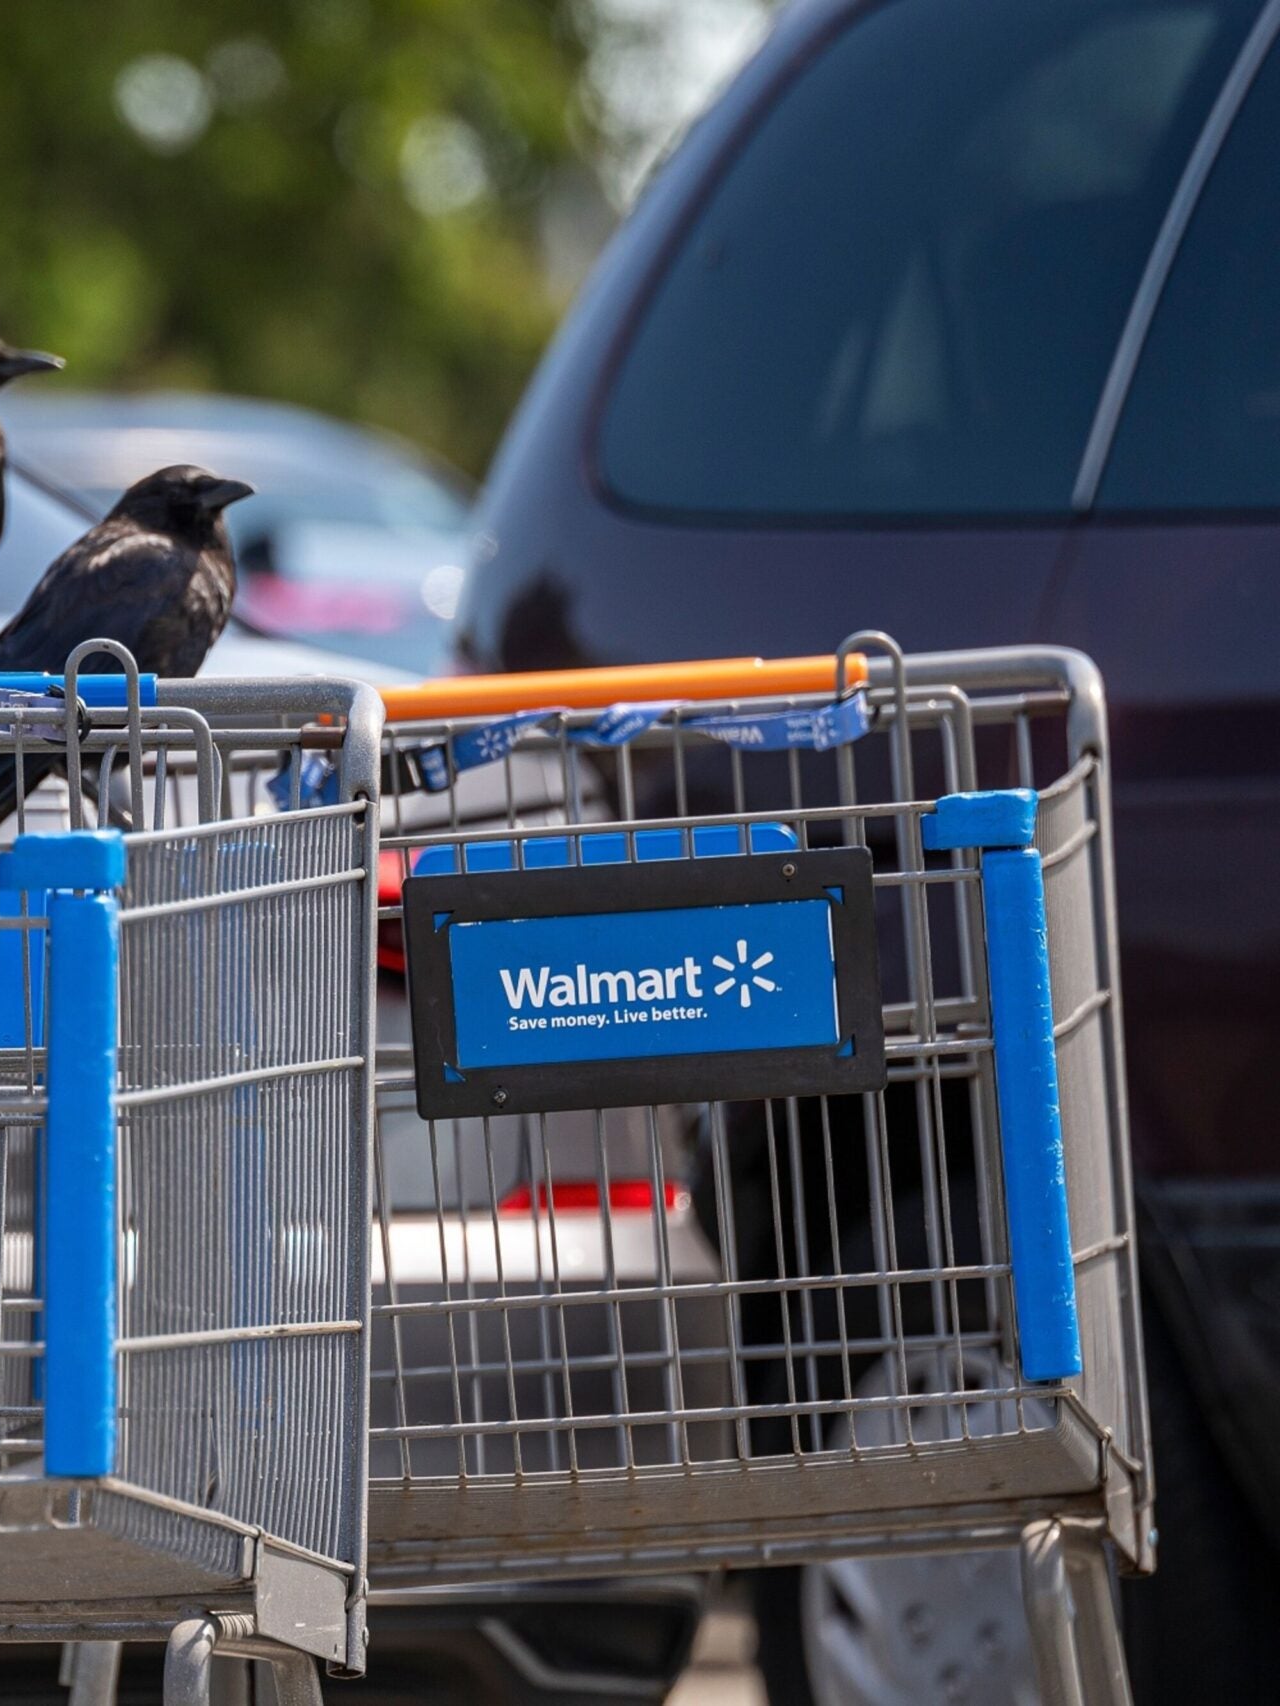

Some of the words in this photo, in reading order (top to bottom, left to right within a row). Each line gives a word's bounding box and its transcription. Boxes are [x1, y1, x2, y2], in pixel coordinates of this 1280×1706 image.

[499, 956, 703, 1010] Walmart
[508, 1016, 547, 1031] Save
[551, 1013, 610, 1029] money.
[614, 1009, 648, 1024] Live
[651, 1006, 709, 1021] better.
